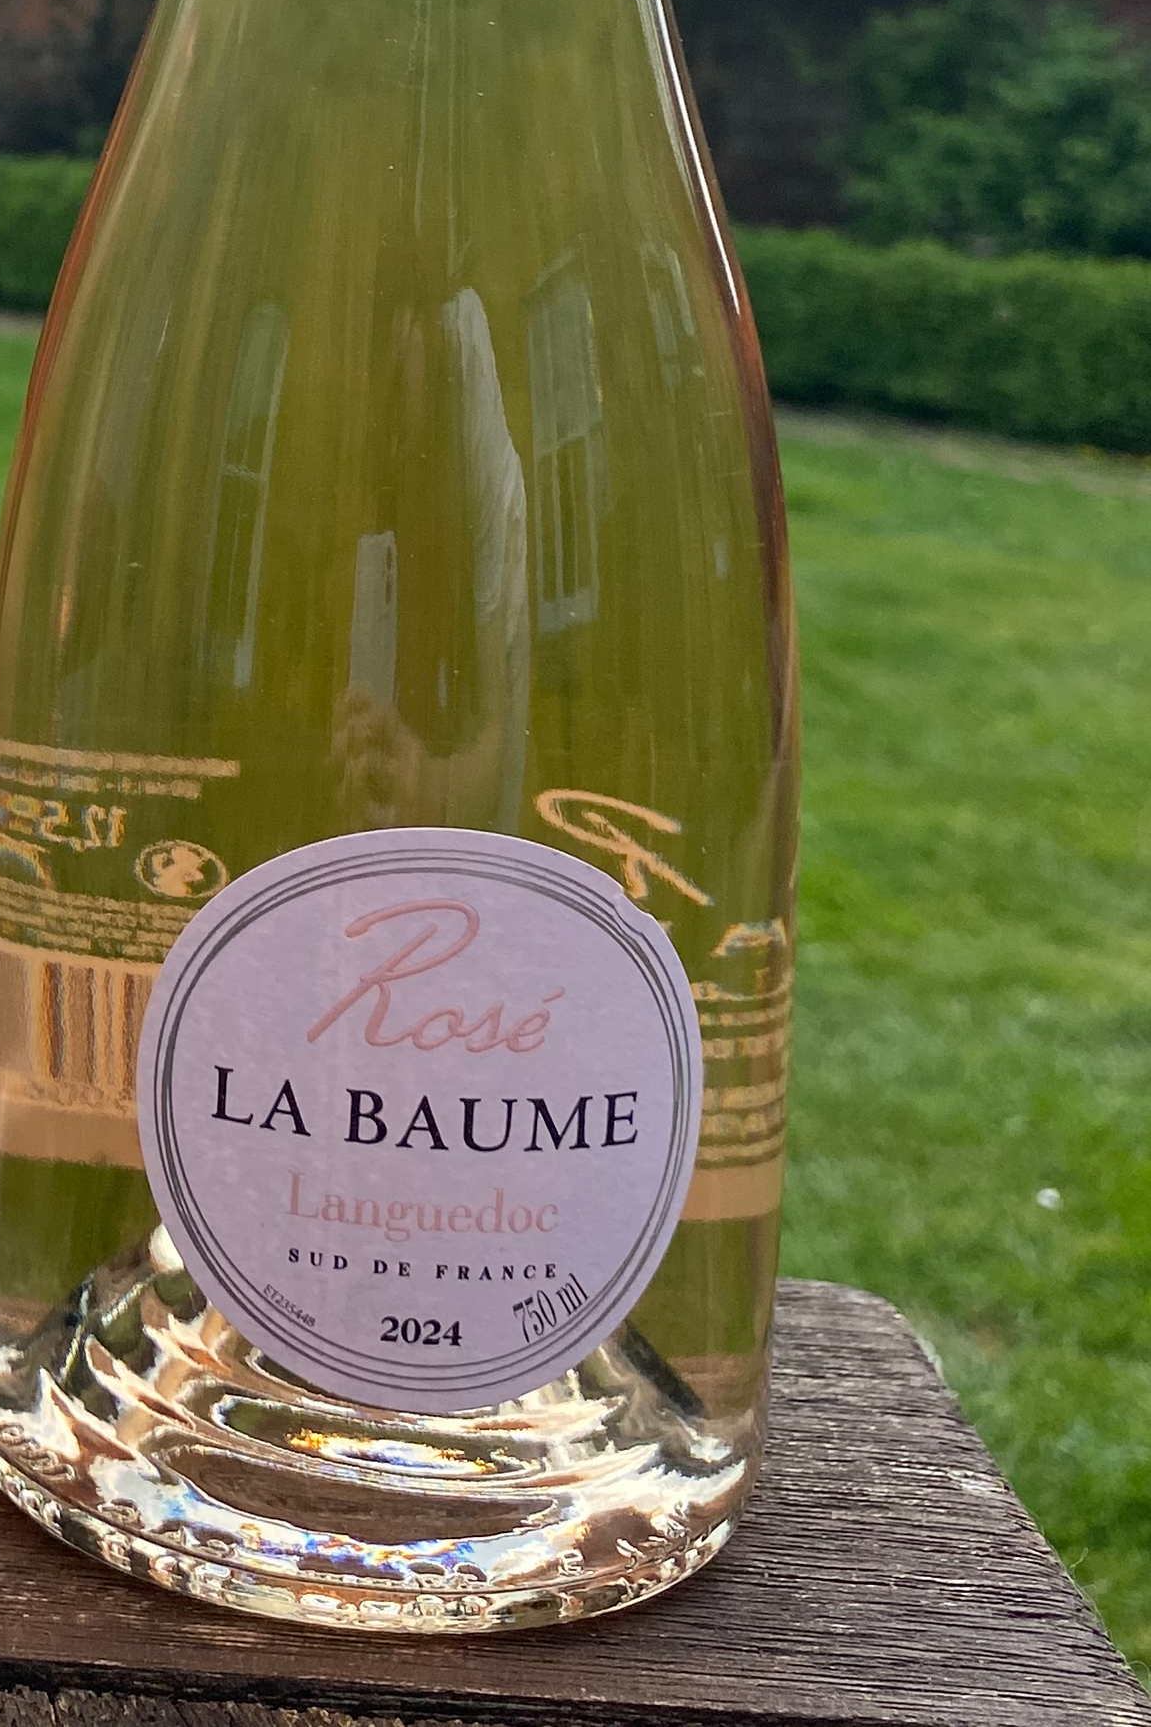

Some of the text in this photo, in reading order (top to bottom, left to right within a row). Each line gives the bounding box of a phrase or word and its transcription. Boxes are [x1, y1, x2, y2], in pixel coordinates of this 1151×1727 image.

[306, 897, 567, 1053] Rosé
[211, 1065, 640, 1152] LA BAUME
[284, 1166, 559, 1242] Languedoc
[288, 1248, 558, 1281] SUD DE FRANCE
[379, 1316, 463, 1347] 2024
[512, 1273, 591, 1343] 750 ml
